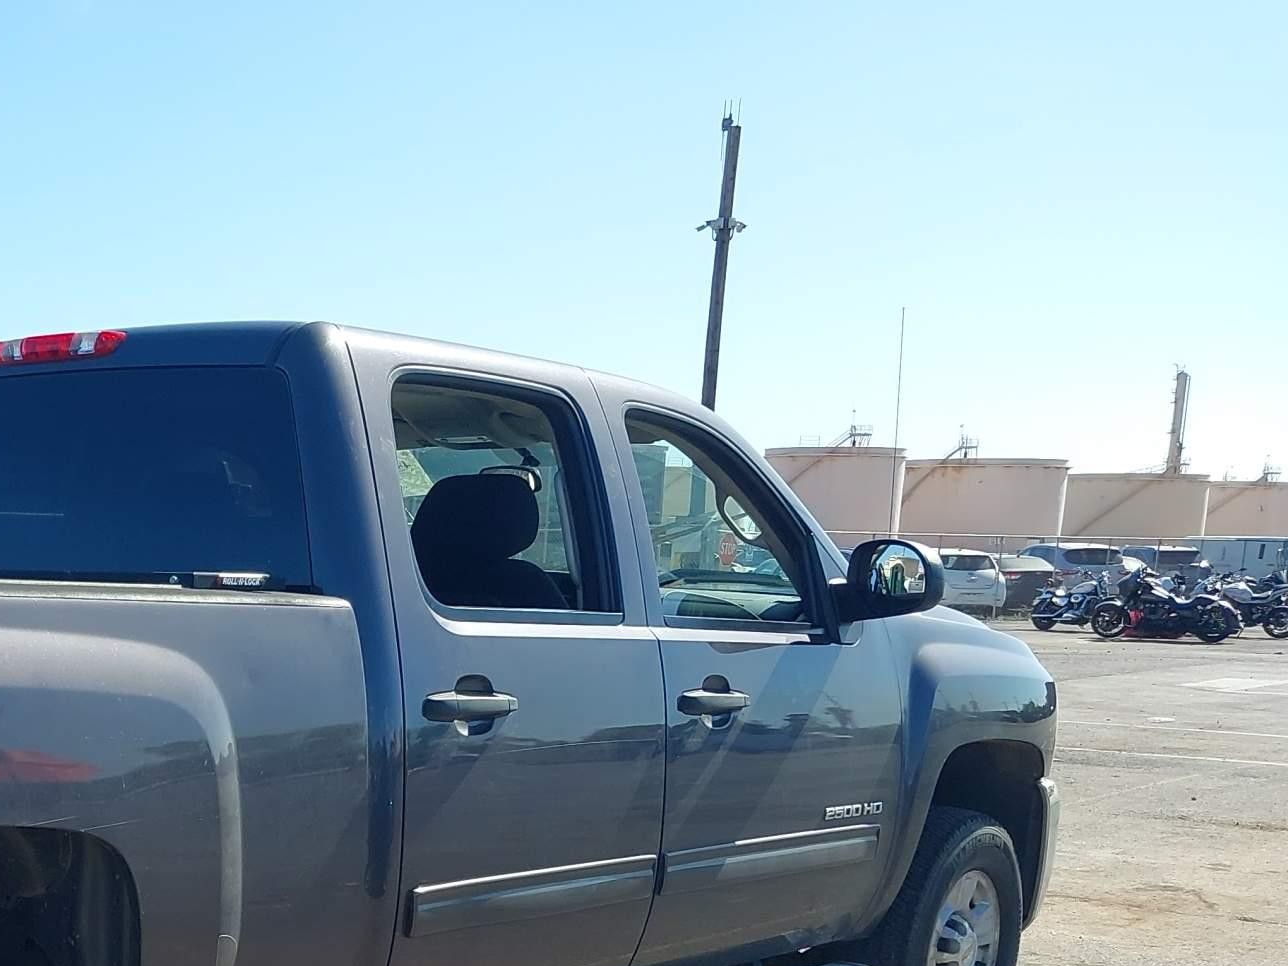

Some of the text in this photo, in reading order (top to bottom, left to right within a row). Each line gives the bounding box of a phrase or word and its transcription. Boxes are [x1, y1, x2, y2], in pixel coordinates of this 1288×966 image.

[721, 542, 737, 555] STOP
[825, 802, 883, 821] 2500 HD
